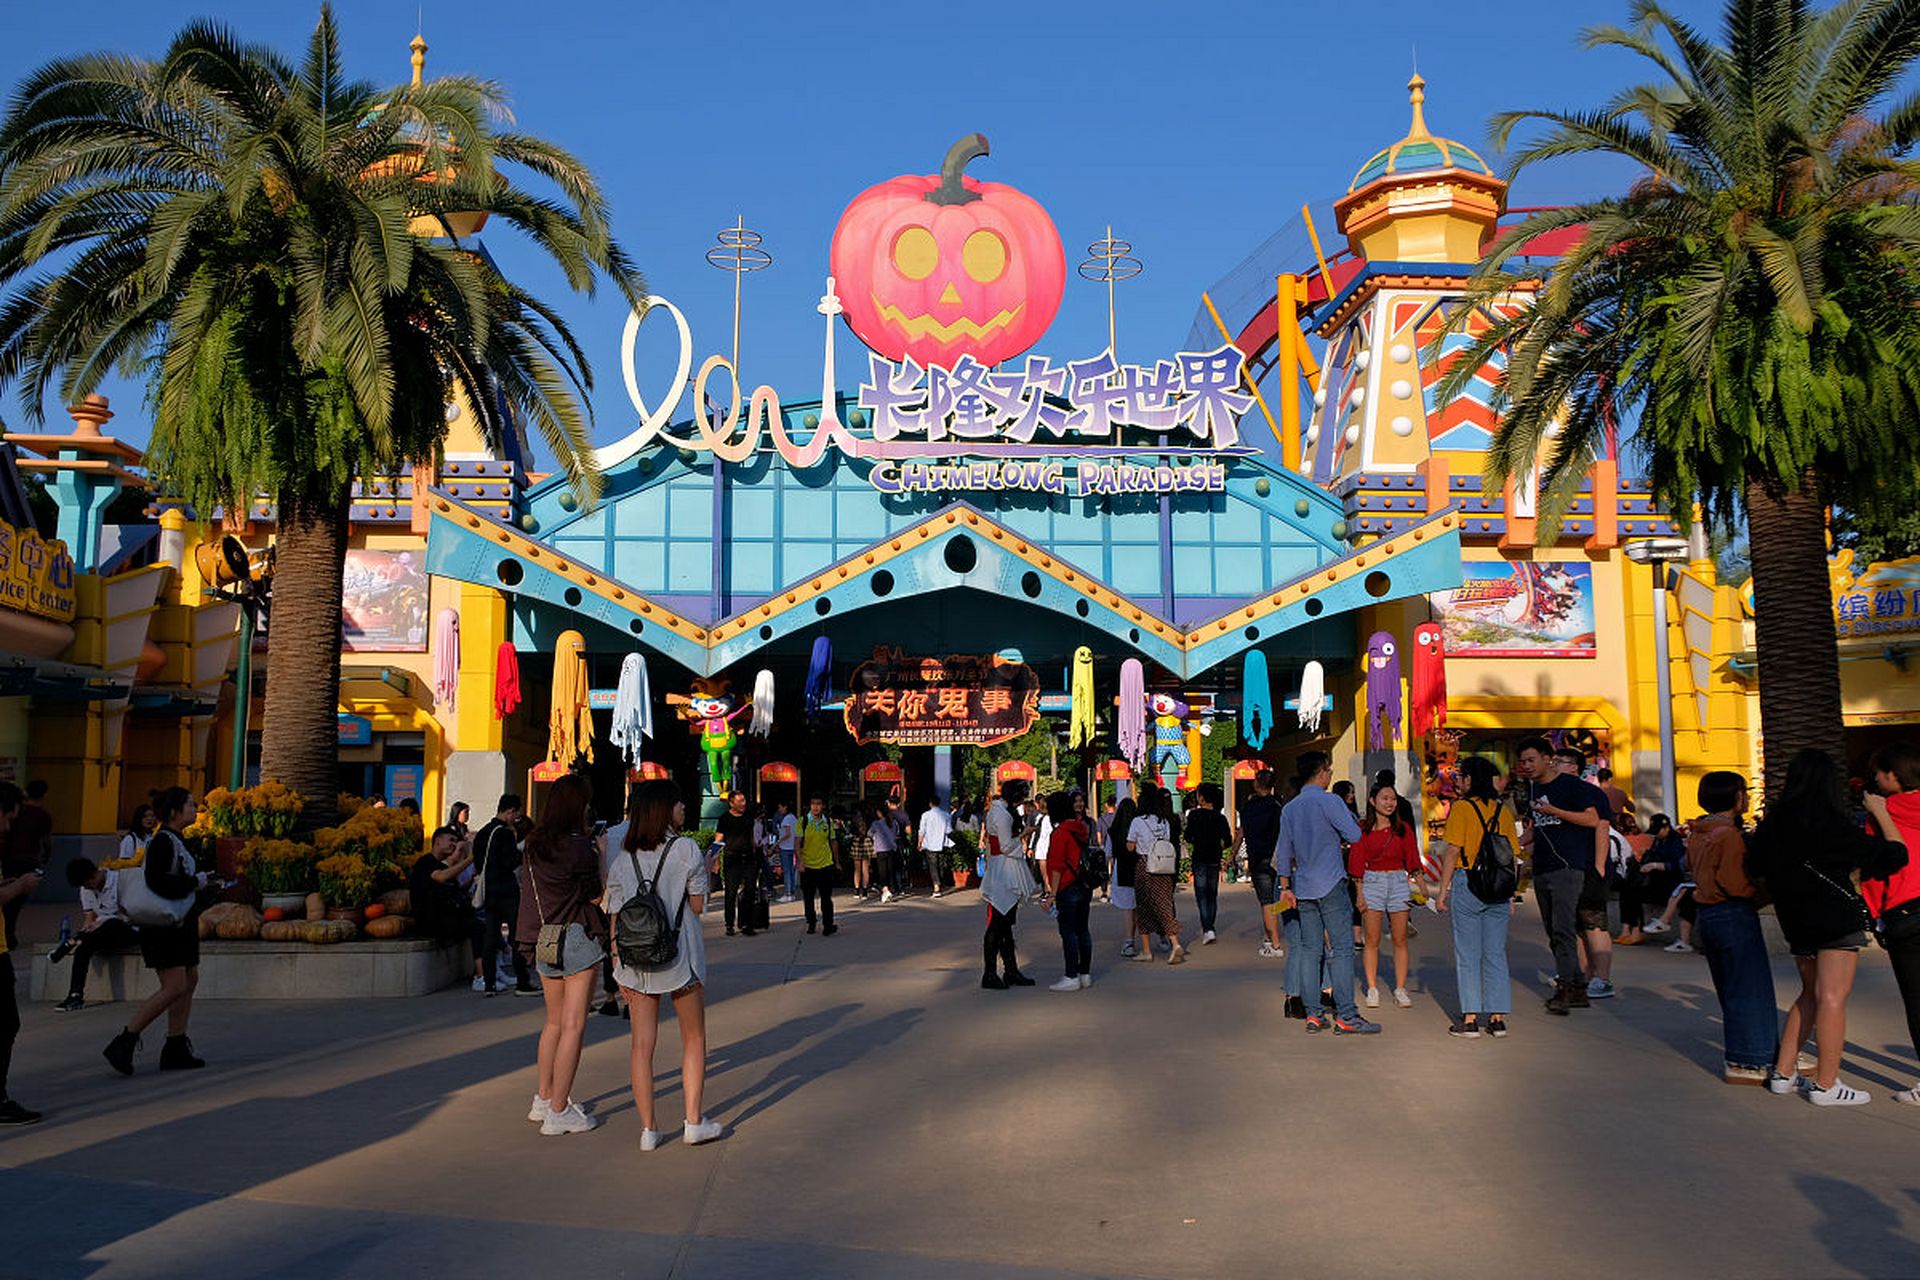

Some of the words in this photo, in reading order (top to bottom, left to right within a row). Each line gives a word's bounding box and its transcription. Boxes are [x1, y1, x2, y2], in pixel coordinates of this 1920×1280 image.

[859, 343, 1257, 450] 长隆欢乐世界
[869, 461, 1064, 494] CHIMELONG
[1078, 461, 1225, 495] PARADISE
[31, 585, 73, 611] Center
